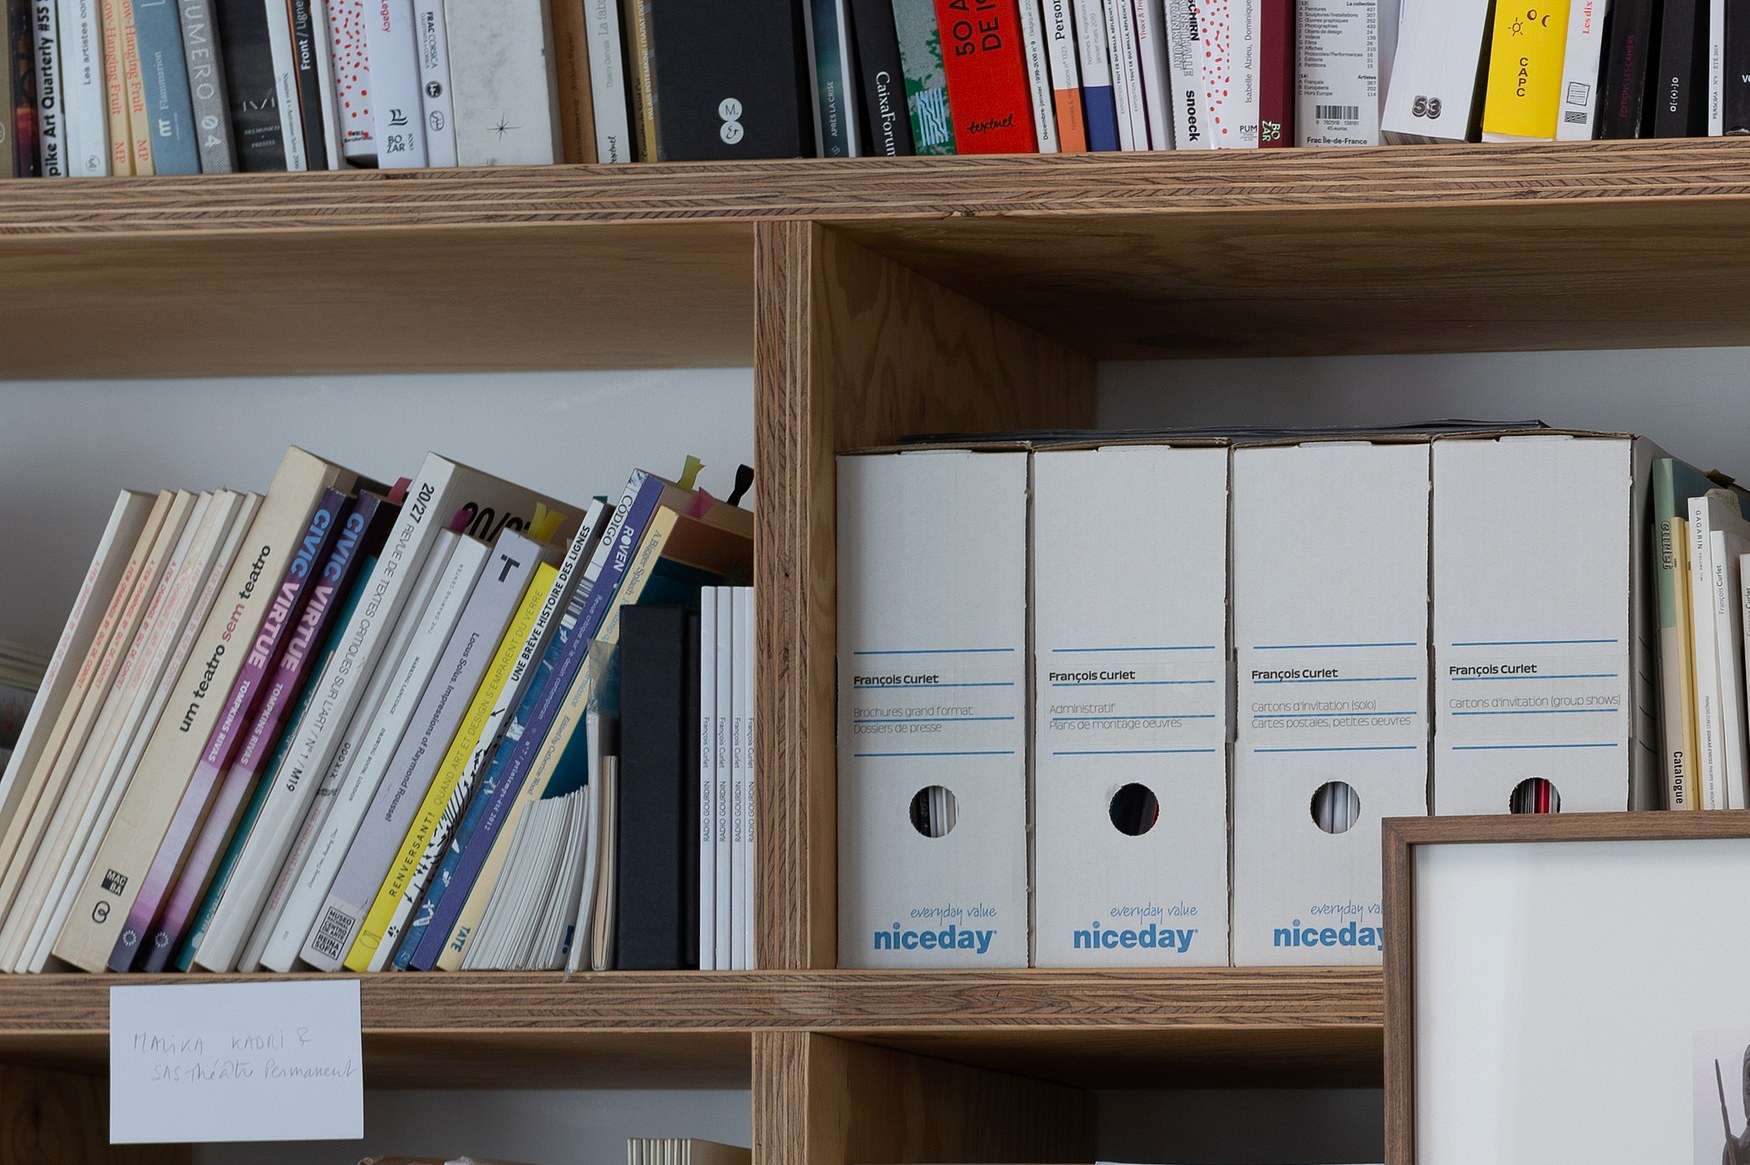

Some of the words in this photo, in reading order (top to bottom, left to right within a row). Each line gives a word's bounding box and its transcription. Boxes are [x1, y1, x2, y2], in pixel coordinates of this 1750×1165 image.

[36, 6, 50, 32] #55
[38, 37, 55, 109] Quarterly
[1516, 57, 1528, 97] CAPC
[1186, 91, 1200, 141] snoeck
[1412, 95, 1442, 118] 53
[43, 116, 56, 139] Art
[967, 114, 1016, 134] textuel
[409, 480, 435, 527] 20/27
[291, 508, 330, 580] CIVIC
[390, 523, 415, 563] REVUE
[566, 524, 591, 557] LIGNES
[613, 525, 635, 573] ROVEN
[386, 561, 398, 579] DE
[559, 552, 575, 577] DES
[367, 576, 391, 618] TEXTES
[537, 576, 563, 625] HISTOIRE
[179, 708, 199, 733] um
[193, 642, 225, 703] teatro
[221, 602, 246, 641] sem
[239, 545, 271, 601] teatro
[249, 582, 300, 671] VIRTUE
[521, 627, 540, 656] BRÈVE
[339, 618, 371, 678] CRITIQUES
[511, 656, 529, 683] UNE
[854, 675, 902, 686] François
[904, 674, 939, 684] Curlet
[1449, 665, 1498, 676] François
[1501, 664, 1537, 674] Curlet
[219, 679, 251, 728] TOMPKINS
[330, 674, 346, 700] SUR
[316, 699, 335, 733] L'ART
[854, 723, 893, 733] Dossiers
[895, 723, 907, 732] de
[909, 722, 942, 733] presse
[208, 727, 231, 764] RIVAS
[286, 767, 303, 793] M19
[1674, 750, 1683, 803] Catalogue
[388, 812, 437, 898] RENVERSANT!
[911, 902, 962, 925] everyday
[967, 902, 996, 918] value
[450, 927, 471, 952] TATE
[874, 922, 993, 954] niceday
